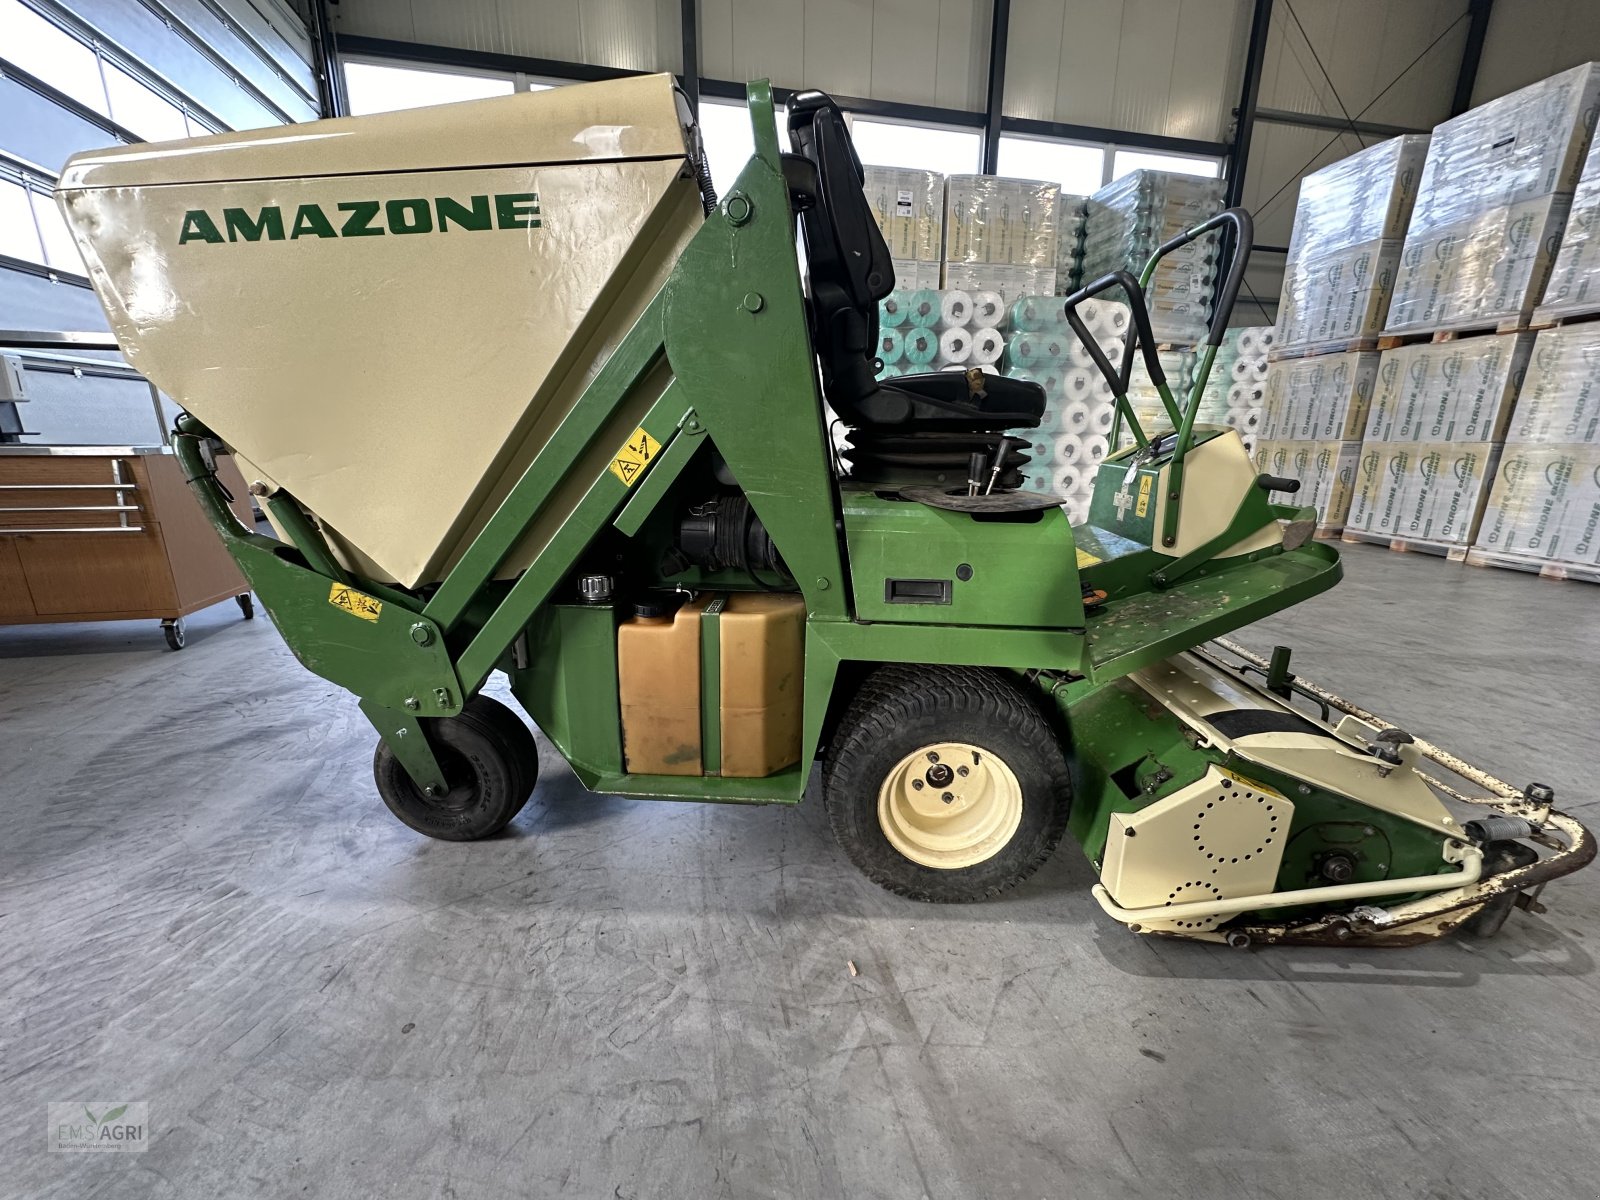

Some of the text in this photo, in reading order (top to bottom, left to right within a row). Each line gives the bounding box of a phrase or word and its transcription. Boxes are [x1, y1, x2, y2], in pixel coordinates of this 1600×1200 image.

[179, 192, 542, 245] AMAZONE
[1405, 392, 1417, 425] KRONE
[1471, 388, 1485, 424] KRONE
[1359, 485, 1369, 515] KRONE
[1385, 487, 1396, 518] KRONE
[1415, 488, 1427, 521] KRONE
[1447, 491, 1461, 525] KRONE
